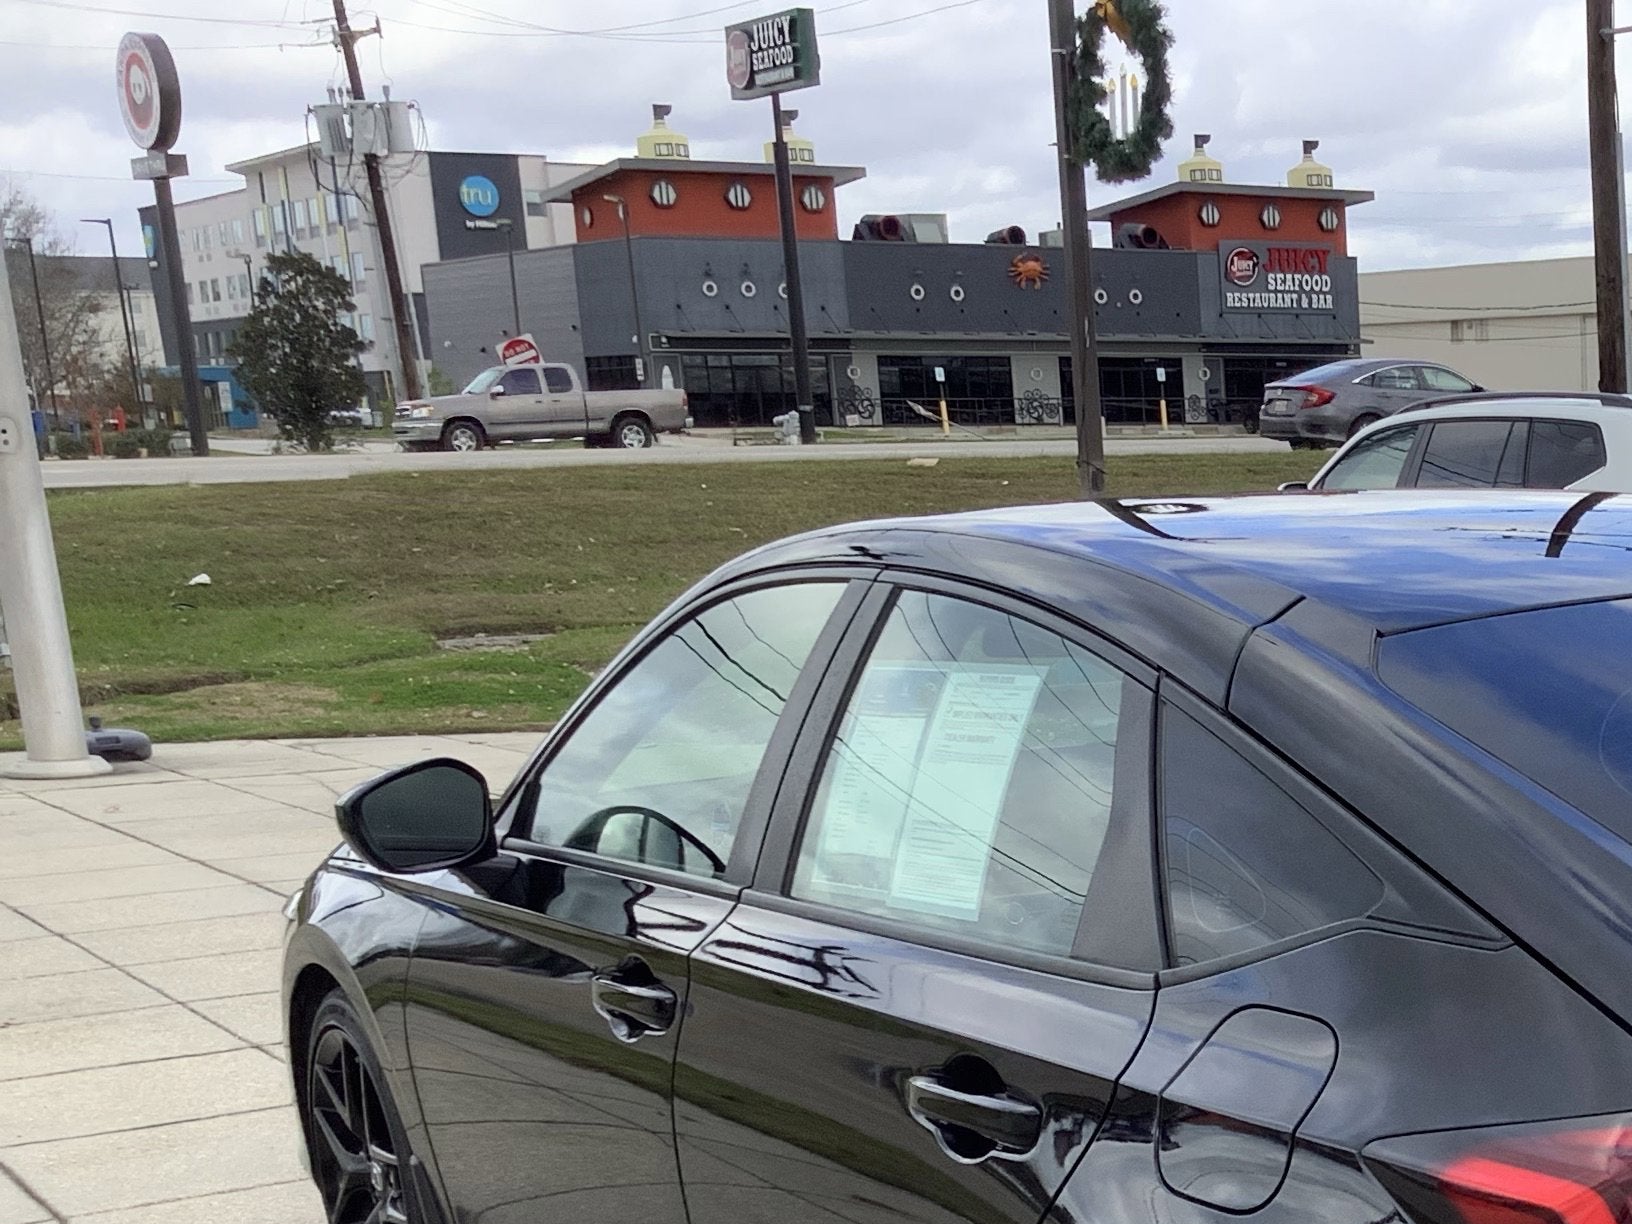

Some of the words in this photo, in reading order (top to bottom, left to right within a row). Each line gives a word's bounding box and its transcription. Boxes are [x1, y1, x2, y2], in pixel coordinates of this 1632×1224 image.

[750, 15, 791, 51] JUICY
[752, 45, 794, 71] SEAFOOD
[461, 184, 492, 206] tru
[1230, 256, 1254, 273] JUICY
[1263, 249, 1330, 273] JUICY
[1267, 273, 1331, 291] SEAFOOD
[1226, 292, 1299, 308] RESTAURANT
[1300, 293, 1310, 309] &
[1311, 293, 1334, 309] BAR
